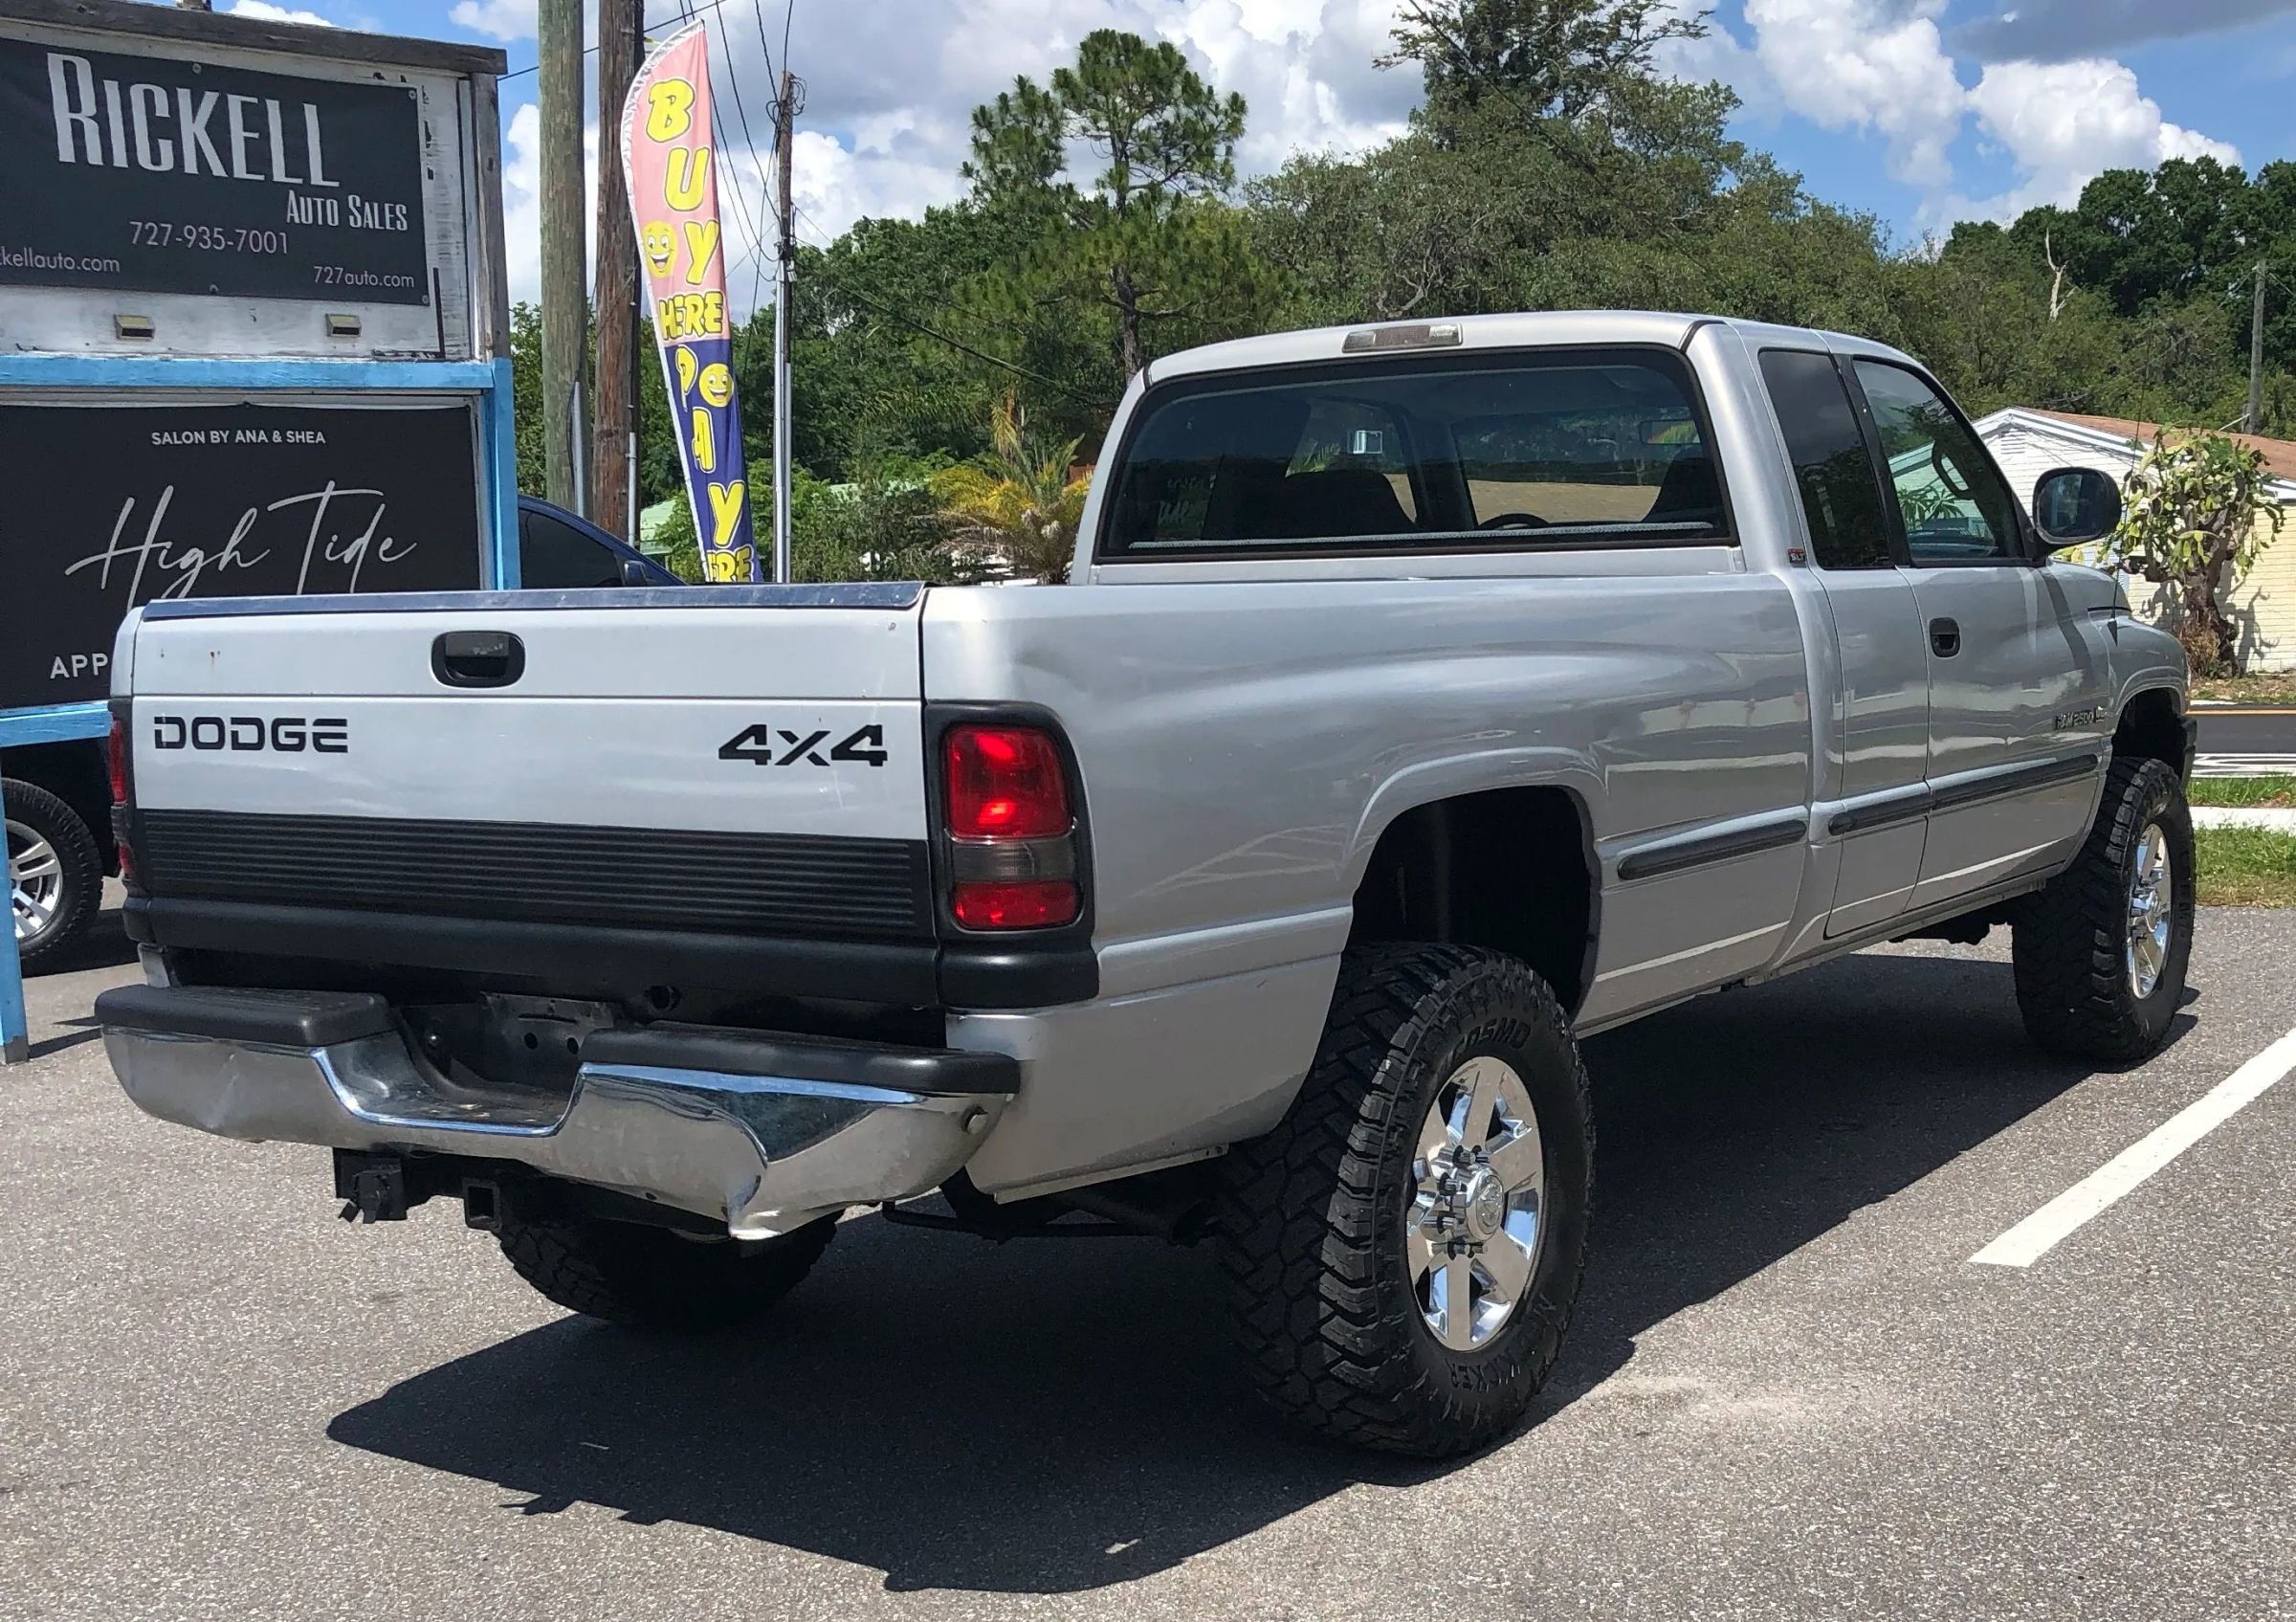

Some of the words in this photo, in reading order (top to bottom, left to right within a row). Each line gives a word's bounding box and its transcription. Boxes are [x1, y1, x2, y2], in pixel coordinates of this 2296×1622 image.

[130, 221, 288, 255] 727-935-7001
[313, 265, 415, 288] 727auto.com
[658, 290, 724, 341] HERE
[151, 431, 206, 446] SALON
[210, 431, 230, 443] BY
[234, 430, 269, 443] ANA
[272, 431, 282, 443] &
[286, 431, 326, 444] SHEA
[65, 485, 271, 611] High
[267, 480, 417, 595] Tide
[154, 716, 348, 753] DODGE
